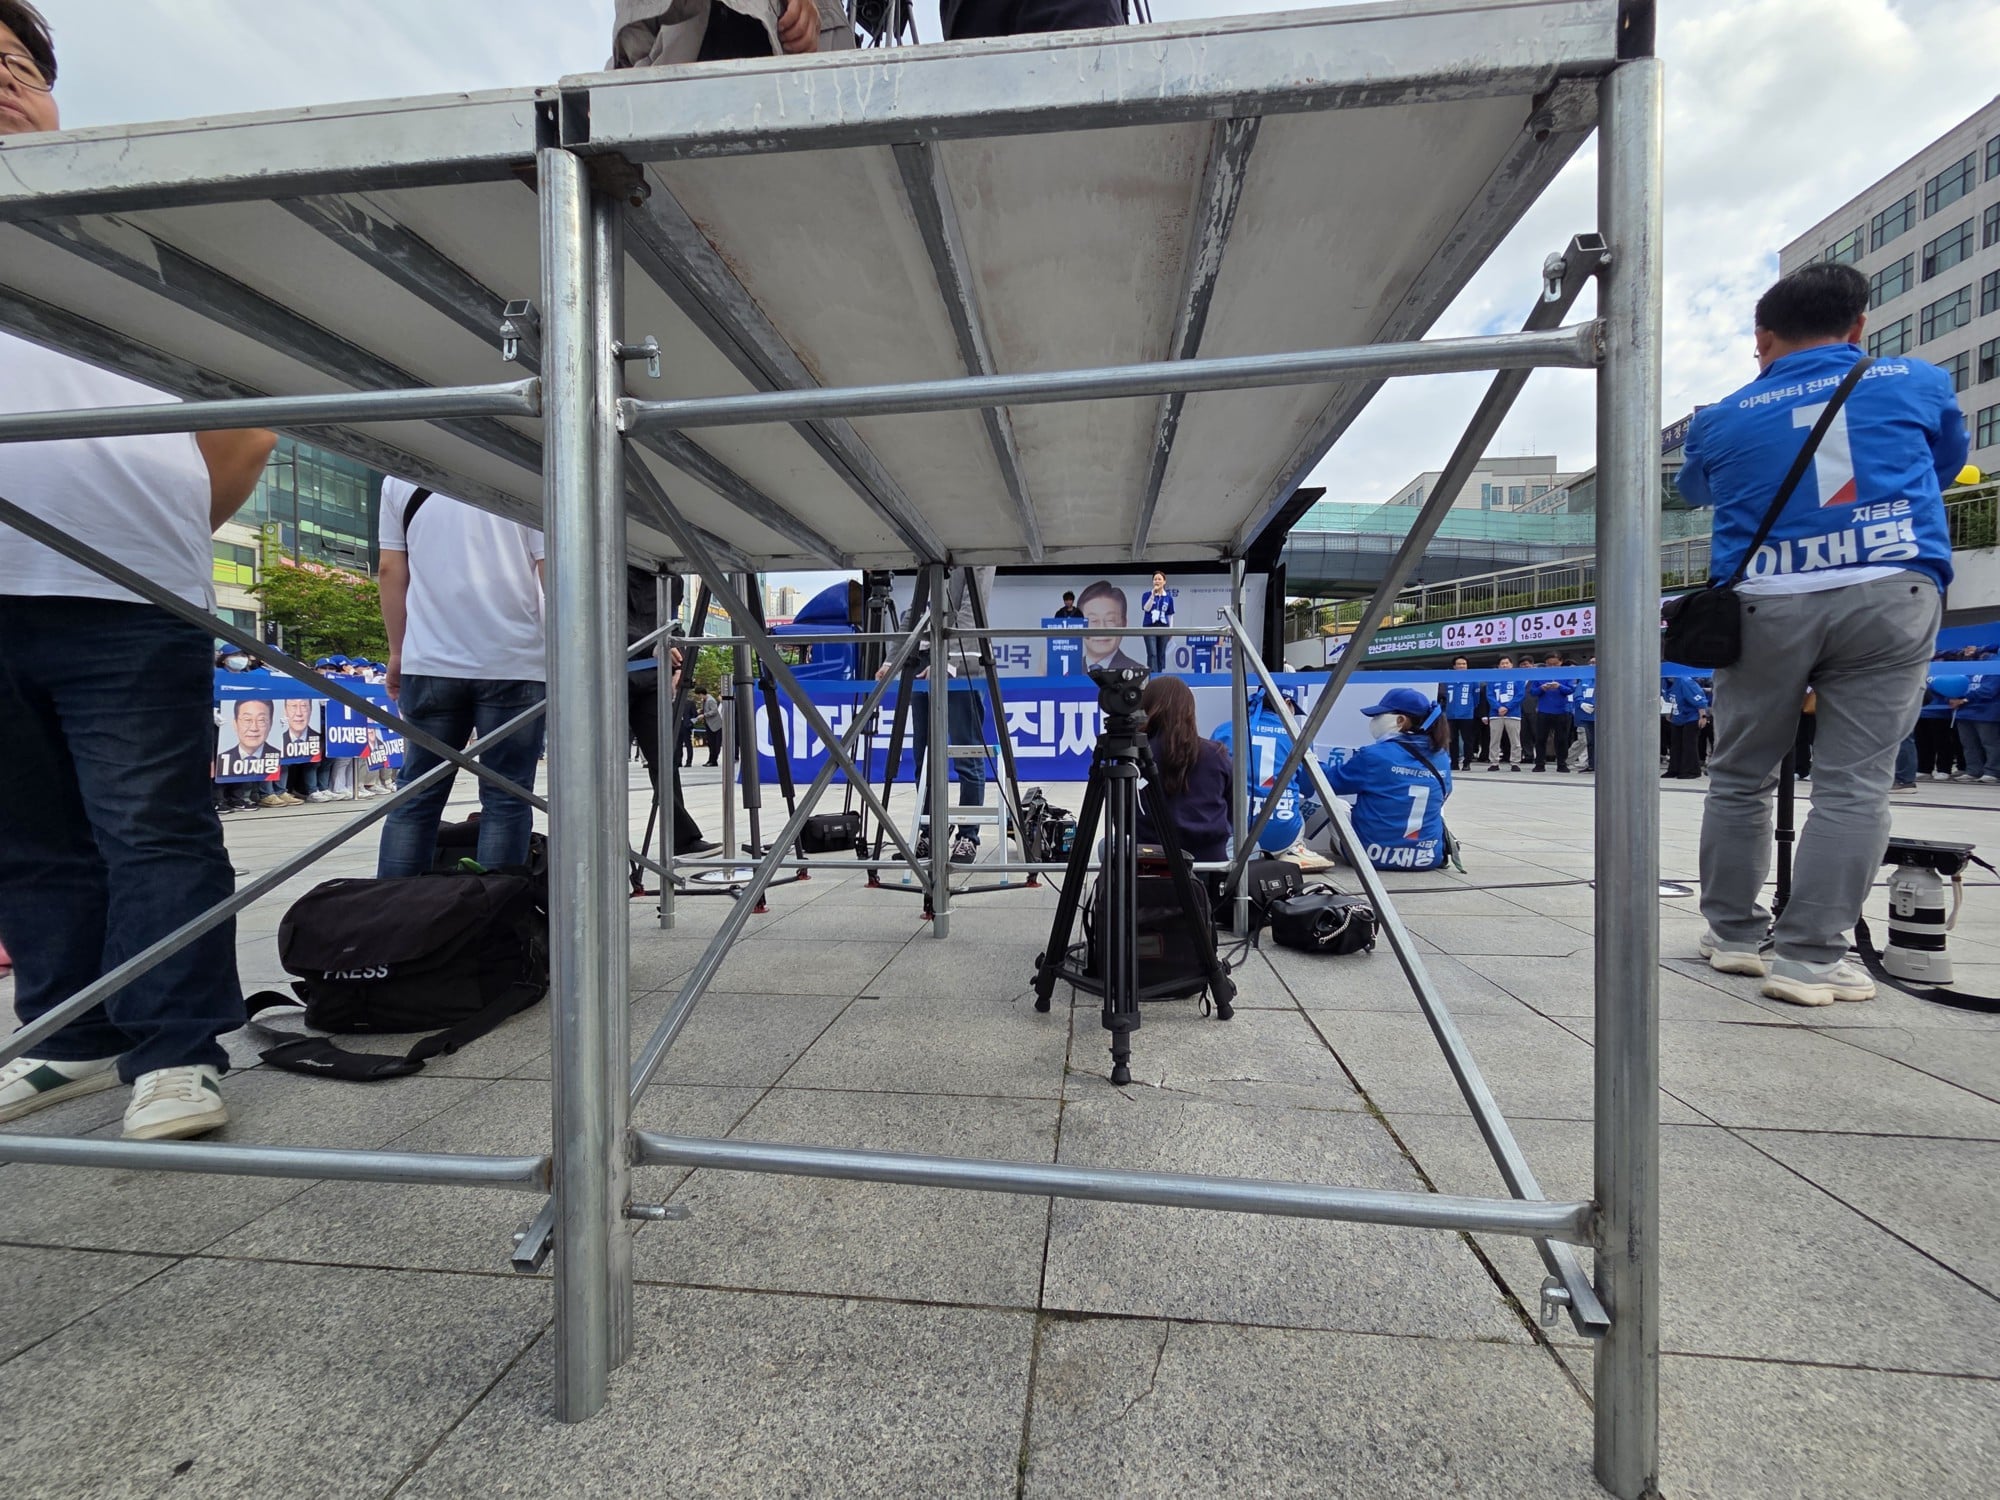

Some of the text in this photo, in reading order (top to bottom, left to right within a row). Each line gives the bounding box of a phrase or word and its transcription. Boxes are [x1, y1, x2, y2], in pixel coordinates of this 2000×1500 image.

[1739, 364, 1910, 409] 이제부터 진짜 한민국
[1792, 401, 1857, 508] 1
[1852, 499, 1912, 523] 지금은
[1746, 517, 1920, 578] 이재명
[1447, 622, 1494, 640] 04.20
[1521, 611, 1578, 632] 05.04
[1447, 640, 1465, 648] 14:00
[1521, 632, 1543, 640] 16:30
[1060, 655, 1069, 676] 1
[328, 726, 368, 744] 이재명
[286, 741, 320, 757] 이재명
[221, 753, 278, 776] 1 이재명
[1252, 735, 1276, 787] 1
[1403, 785, 1430, 839] 1
[1366, 843, 1436, 867] 이재명
